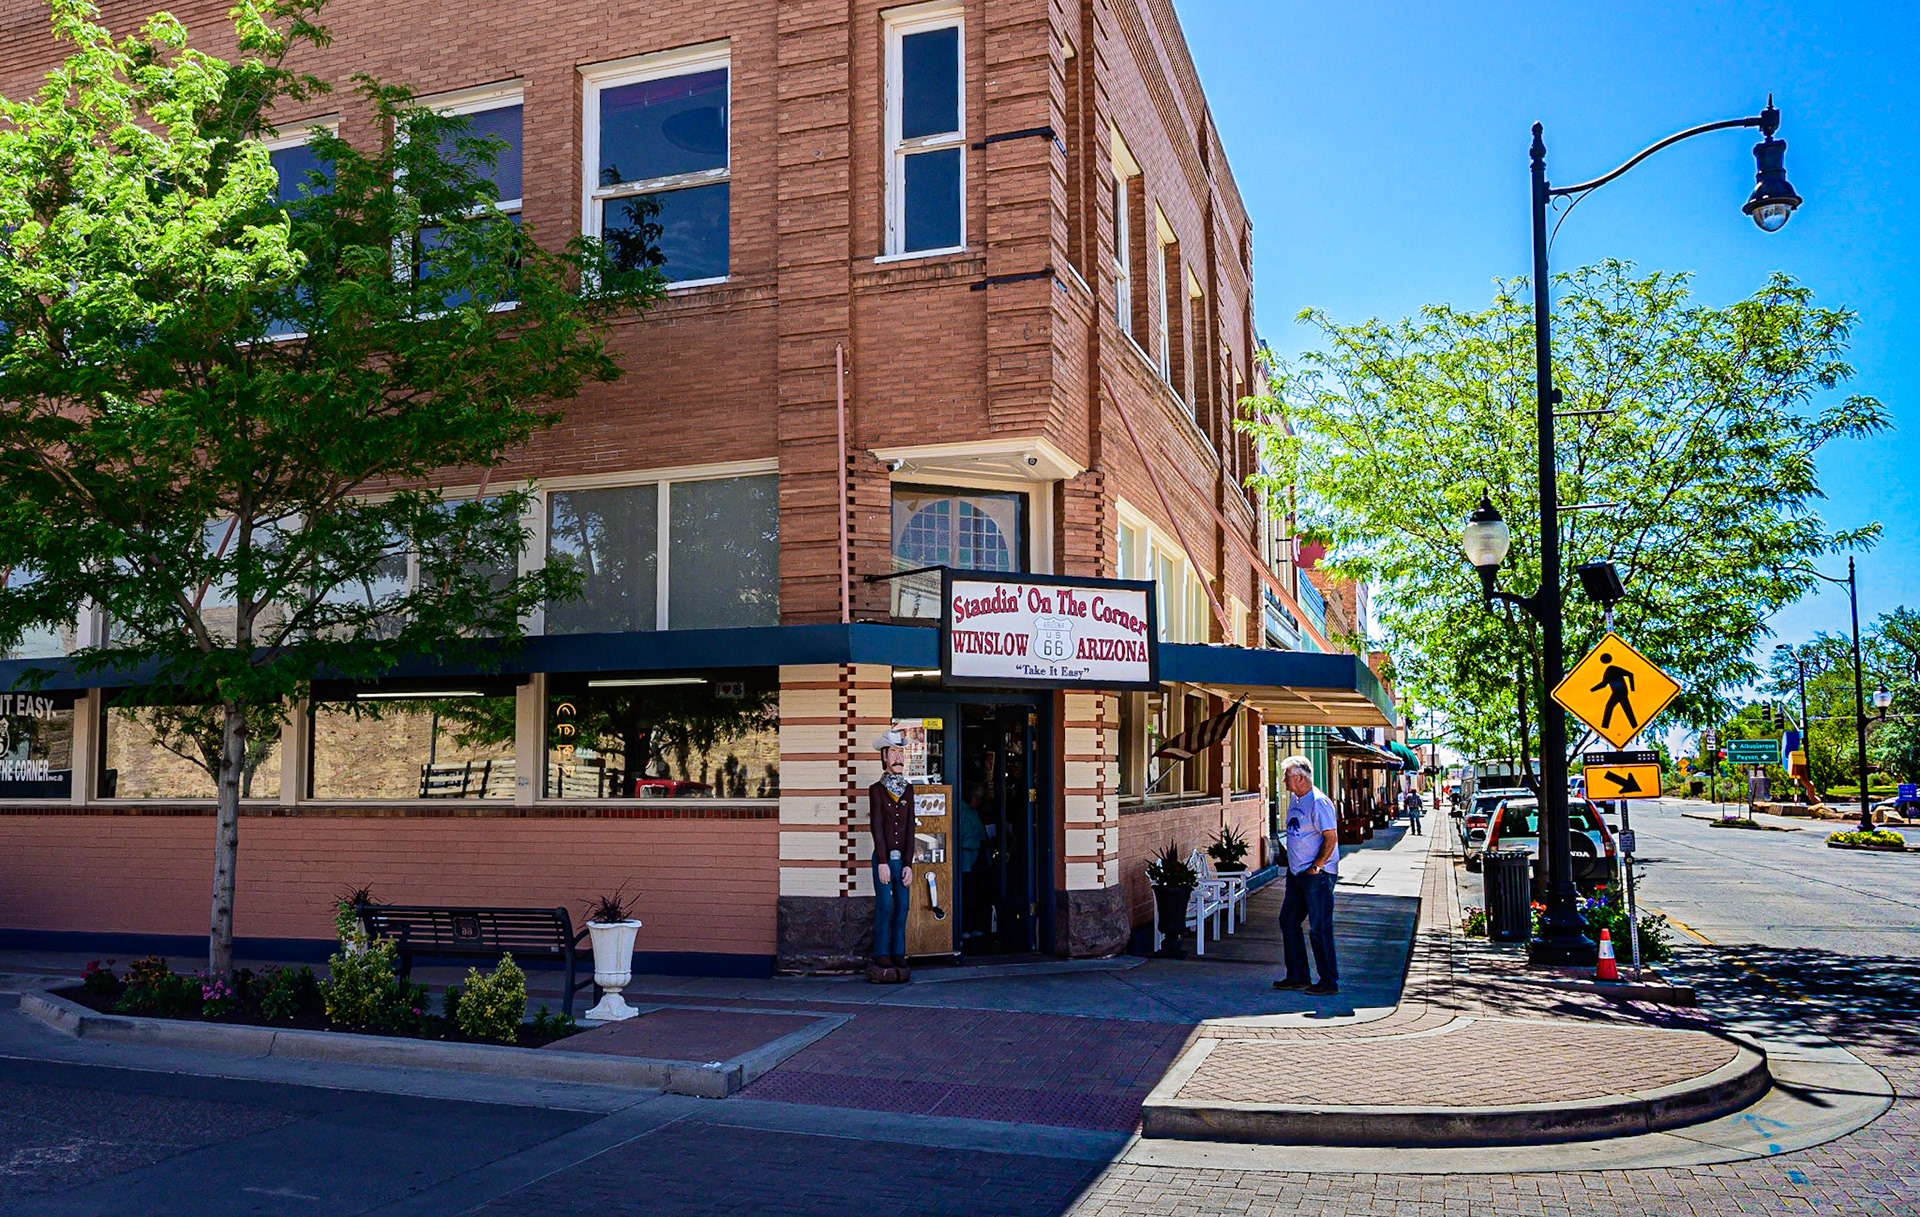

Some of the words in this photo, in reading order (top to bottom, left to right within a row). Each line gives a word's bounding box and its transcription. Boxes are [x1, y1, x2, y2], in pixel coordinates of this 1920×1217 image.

[953, 585, 1023, 623] Standin'
[1028, 587, 1052, 614] On
[1057, 589, 1087, 618] The
[1092, 596, 1147, 637] Corner
[951, 630, 1030, 656] WINSLOW
[1044, 639, 1063, 656] 66
[1076, 638, 1148, 662] ARIZONA
[1016, 665, 1046, 676] "Take
[1049, 666, 1058, 676] It
[1061, 666, 1090, 680] Easy"
[15, 759, 49, 782] CORNER
